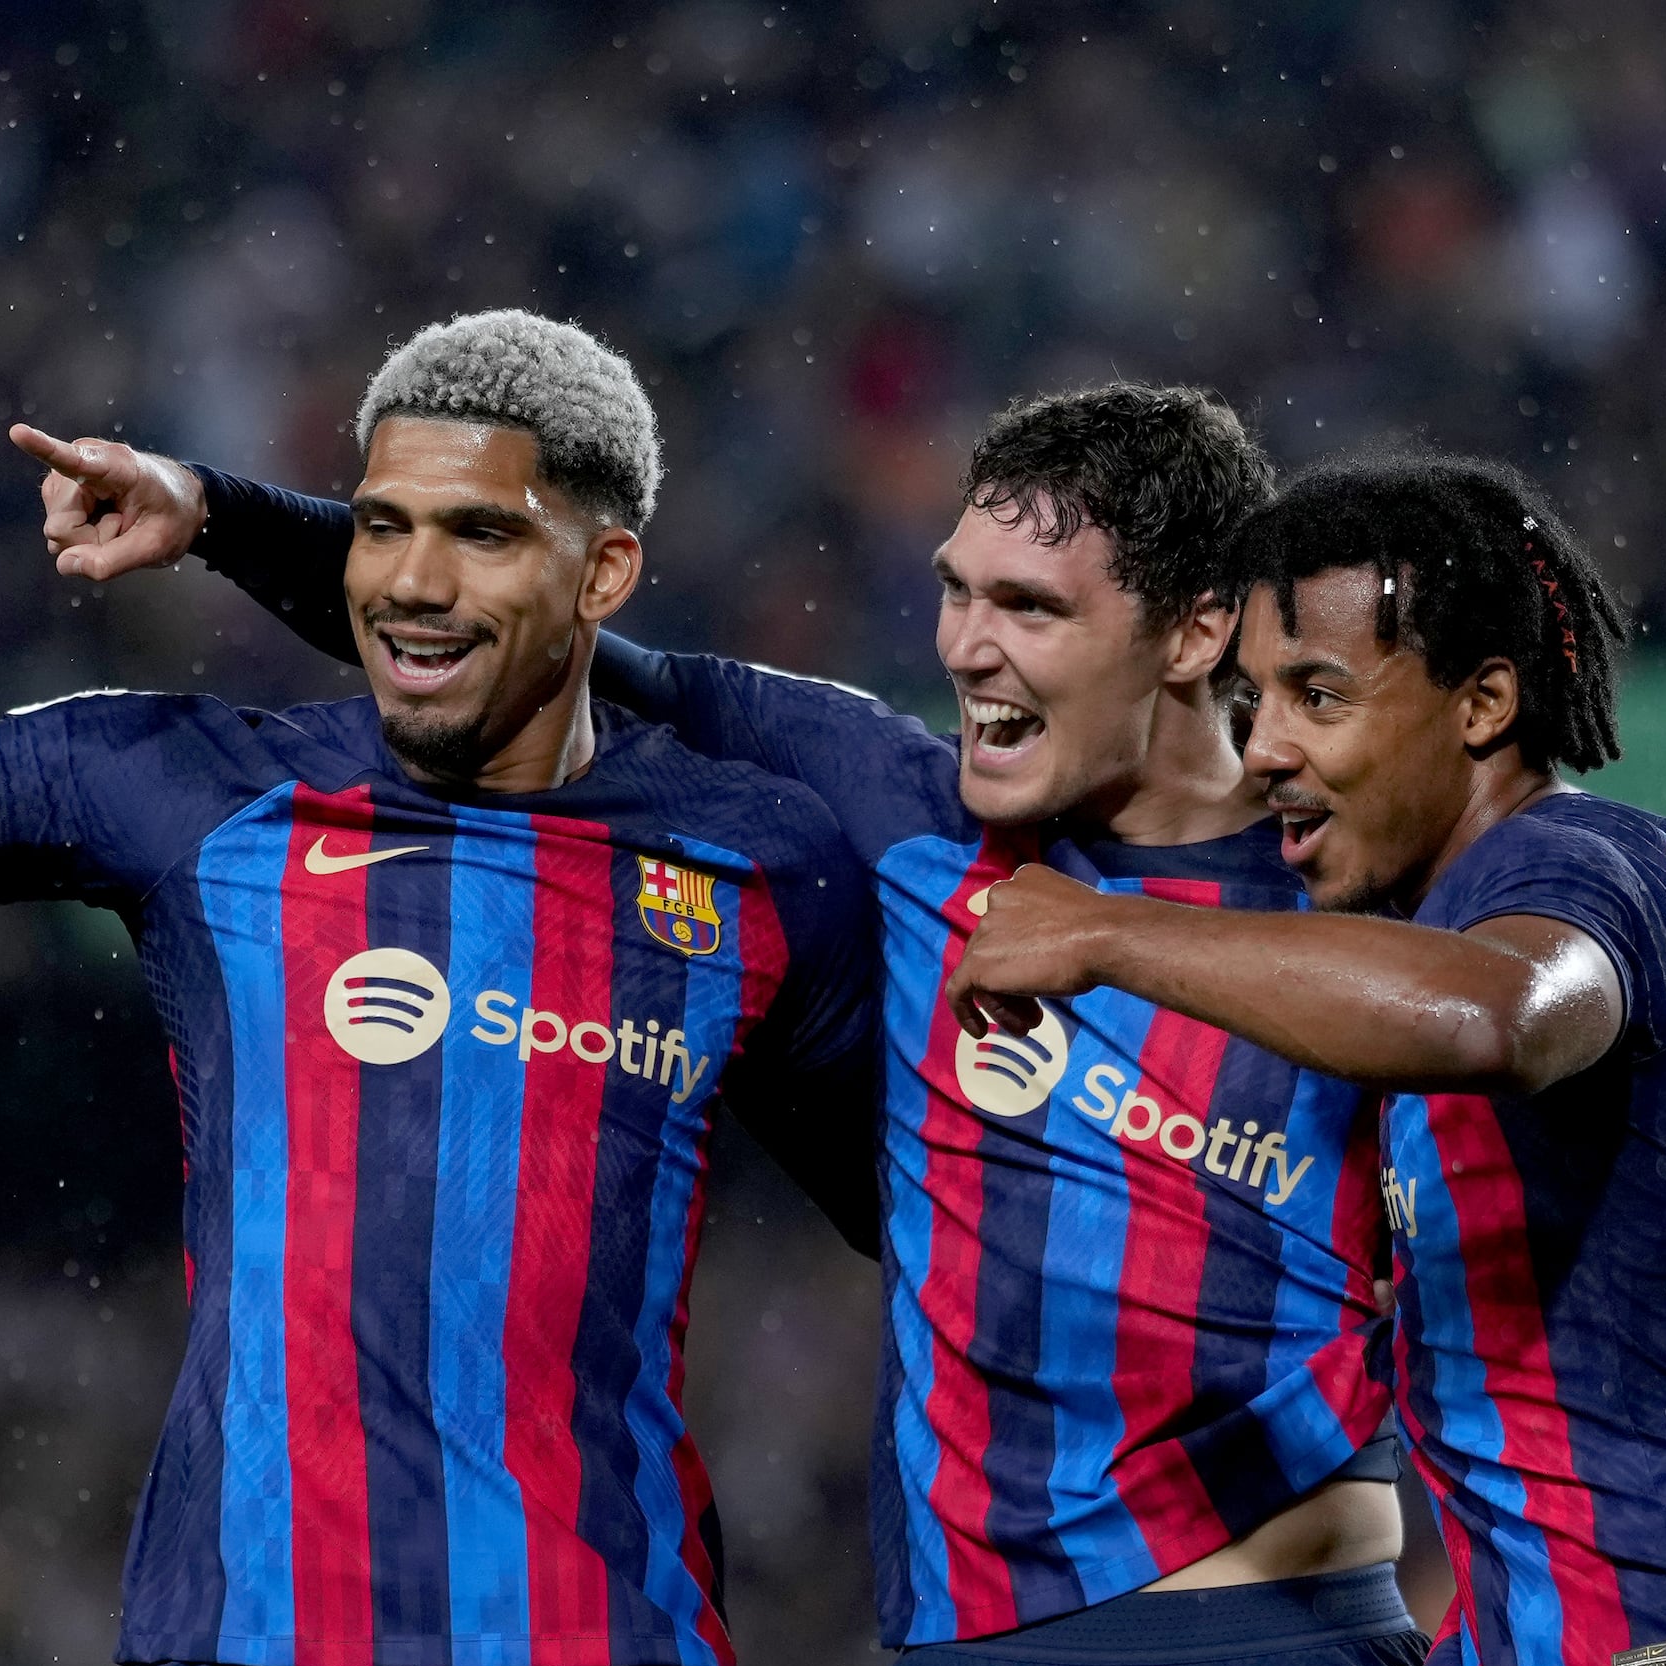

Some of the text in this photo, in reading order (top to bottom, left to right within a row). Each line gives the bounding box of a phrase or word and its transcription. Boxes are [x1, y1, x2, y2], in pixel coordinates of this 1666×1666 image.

[662, 899, 695, 917] FCB
[470, 989, 710, 1104] Spotify
[1071, 1063, 1315, 1205] Spotify
